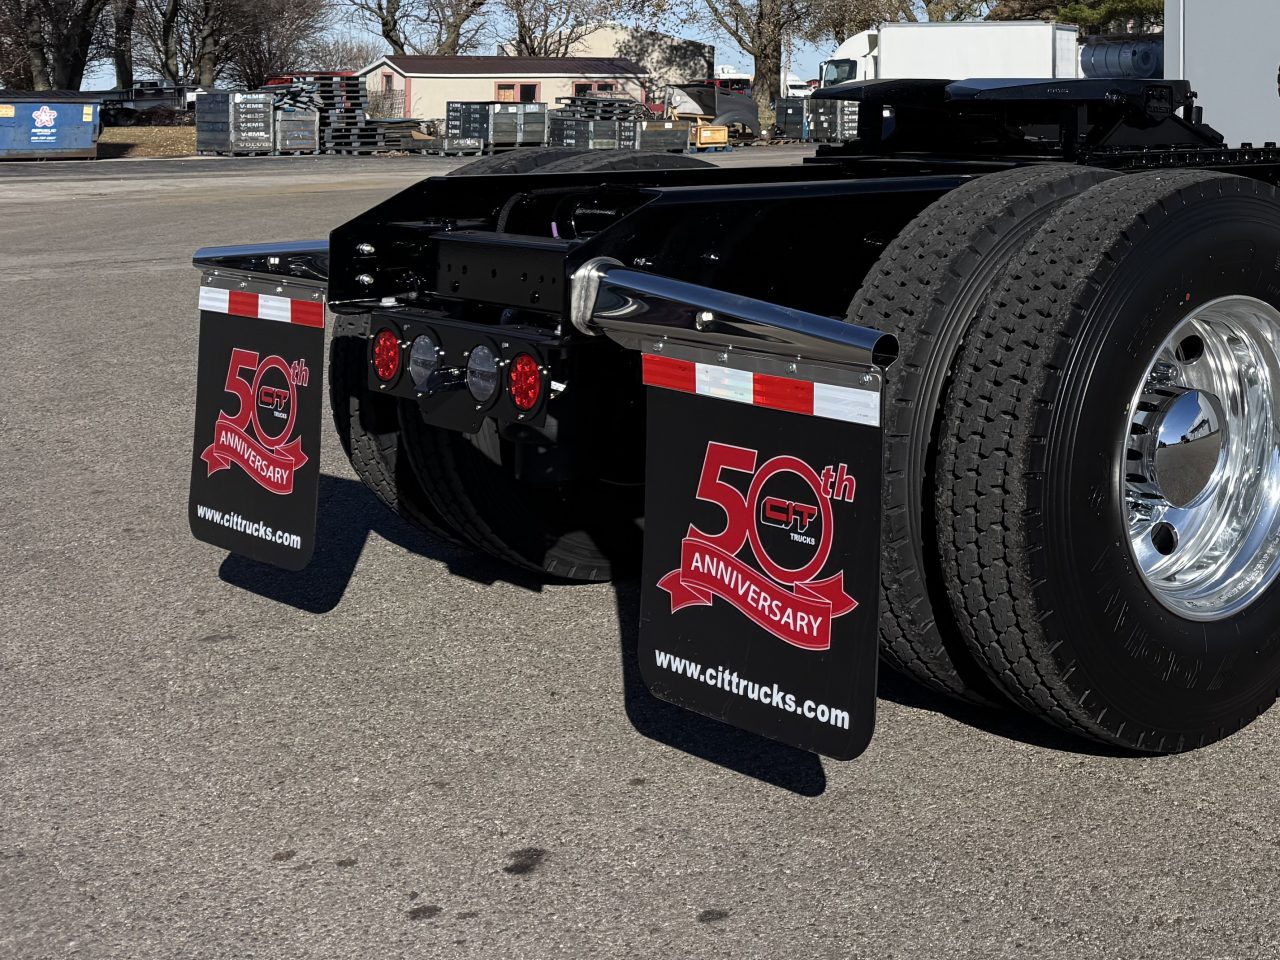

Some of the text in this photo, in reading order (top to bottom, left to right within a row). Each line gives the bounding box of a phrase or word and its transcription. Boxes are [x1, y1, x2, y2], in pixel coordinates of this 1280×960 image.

[258, 385, 290, 411] CIT
[219, 430, 290, 486] ANNIVERSARY
[197, 504, 301, 550] www.cittrucks.com
[760, 496, 818, 533] CIT
[789, 533, 816, 546] TRUCKS
[690, 551, 822, 639] ANNIVERSARY
[655, 649, 850, 730] www.cittrucks.com
